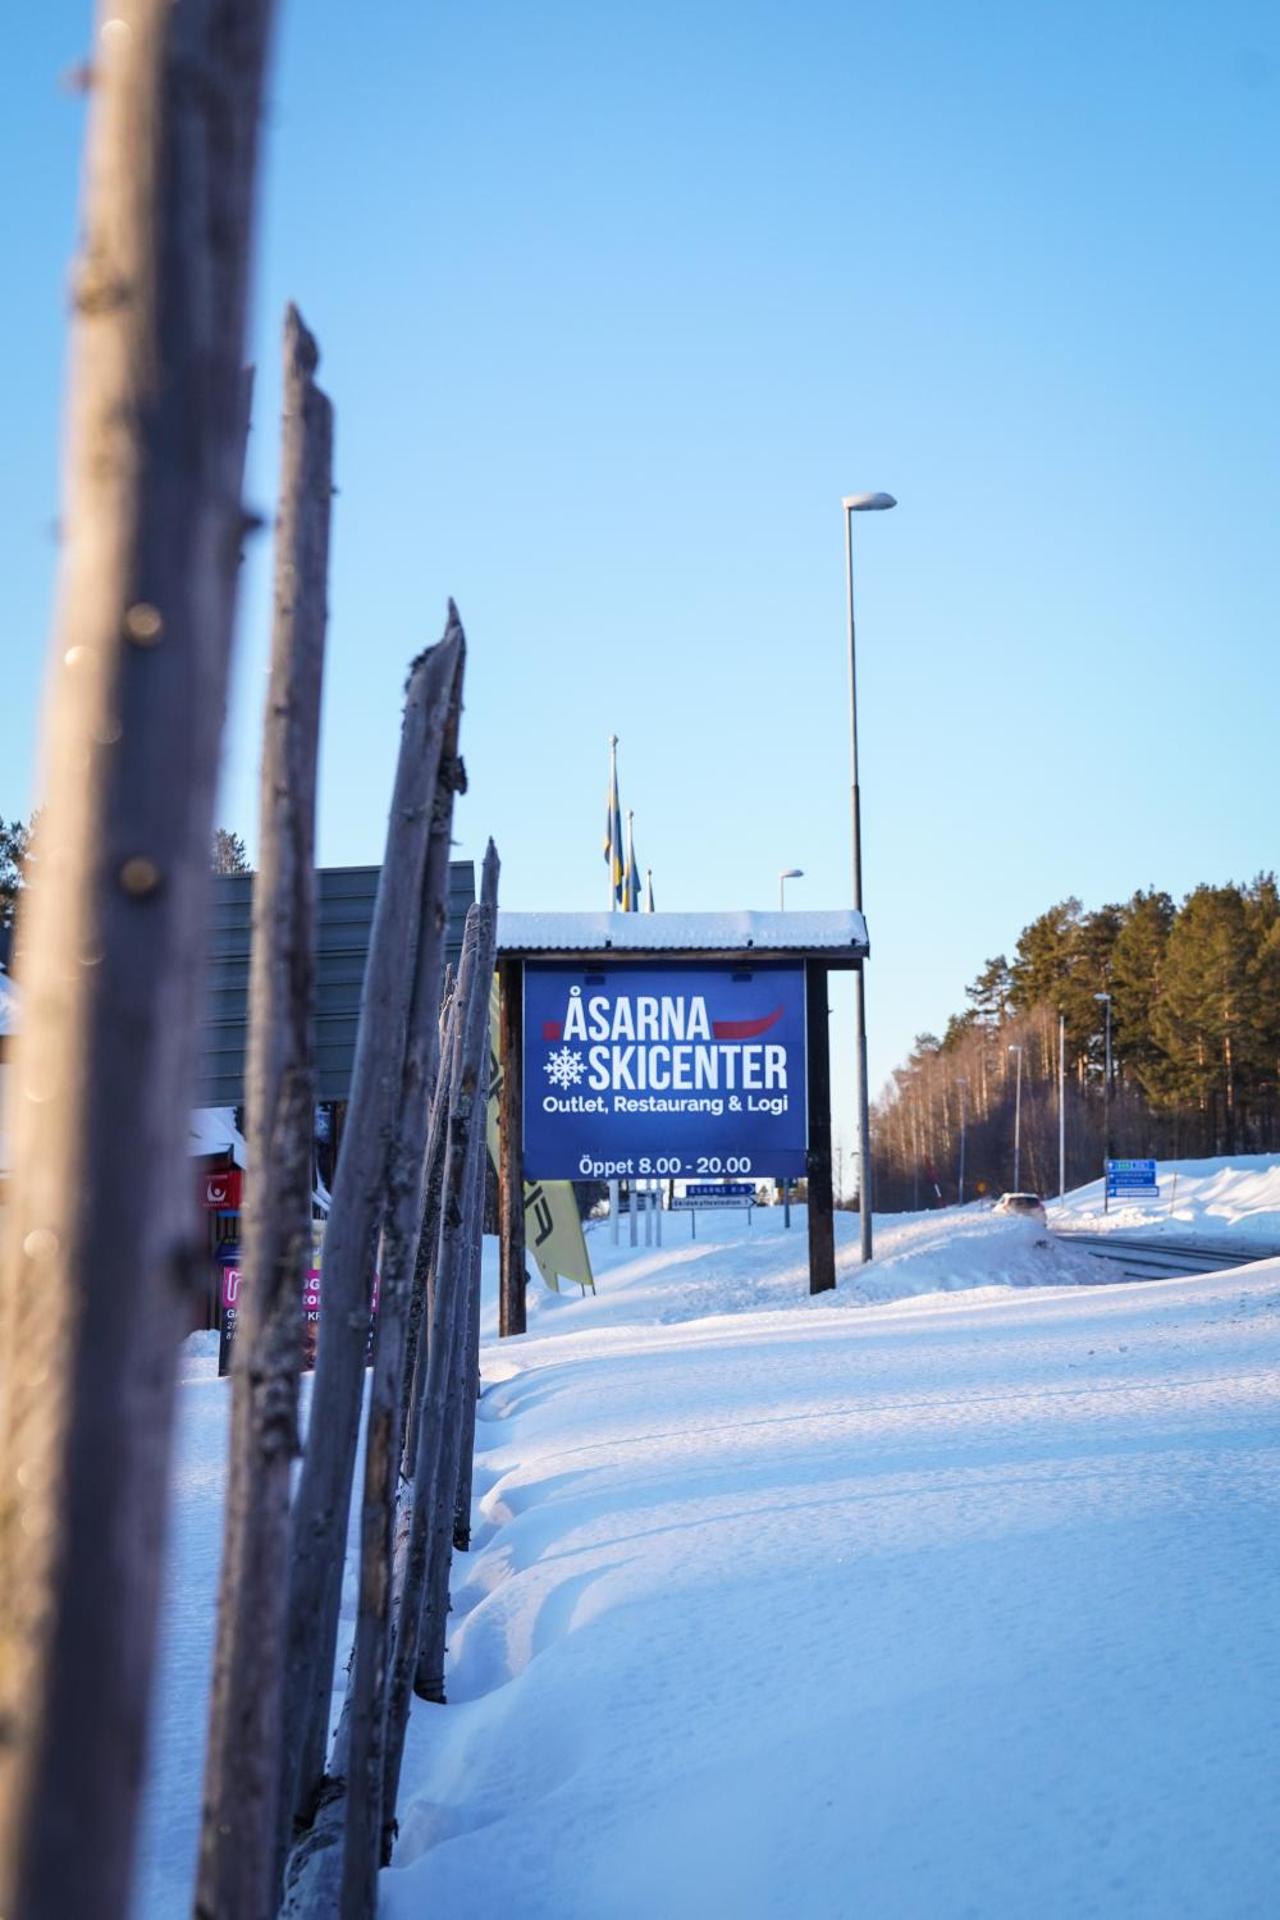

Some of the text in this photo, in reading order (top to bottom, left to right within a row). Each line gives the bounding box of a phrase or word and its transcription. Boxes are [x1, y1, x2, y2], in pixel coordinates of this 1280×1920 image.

[563, 985, 711, 1041] ÅSARNA
[588, 1045, 787, 1090] SKICENTER
[543, 1094, 788, 1116] Outlet, Restaurang & Logi
[579, 1155, 634, 1178] Öppet
[638, 1157, 682, 1174] 8.00
[696, 1156, 752, 1173] 20.00
